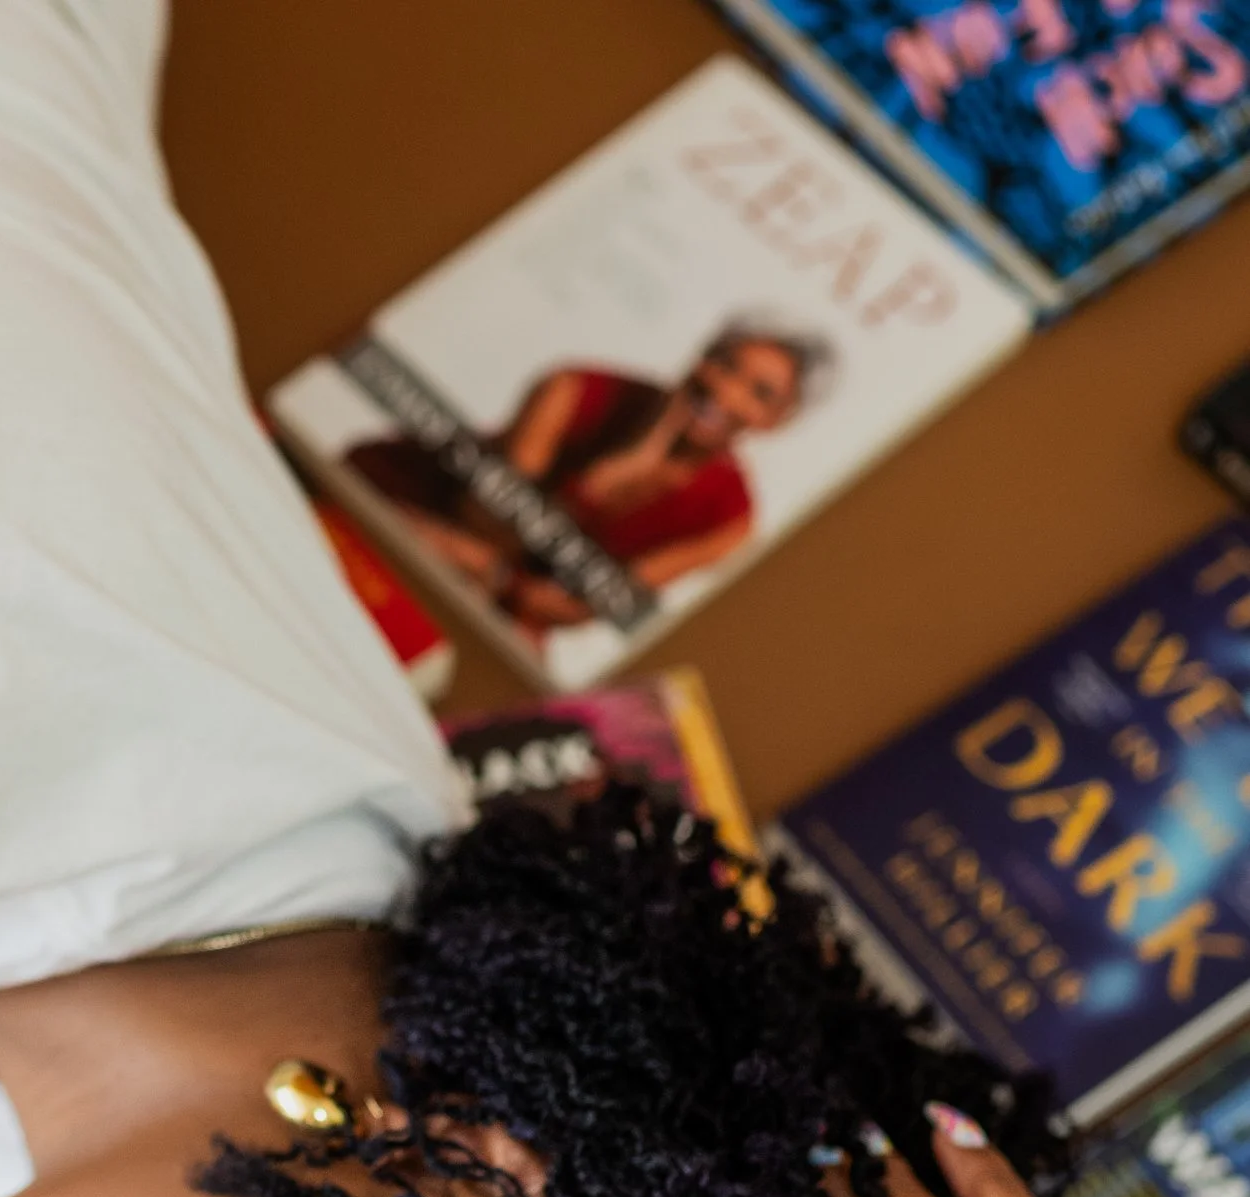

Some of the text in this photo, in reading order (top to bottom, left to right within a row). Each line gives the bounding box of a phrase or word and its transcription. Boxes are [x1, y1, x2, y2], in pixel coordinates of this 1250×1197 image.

[1193, 543, 1250, 630] T
[1113, 612, 1240, 742] WE
[955, 700, 1245, 1000] DARK
